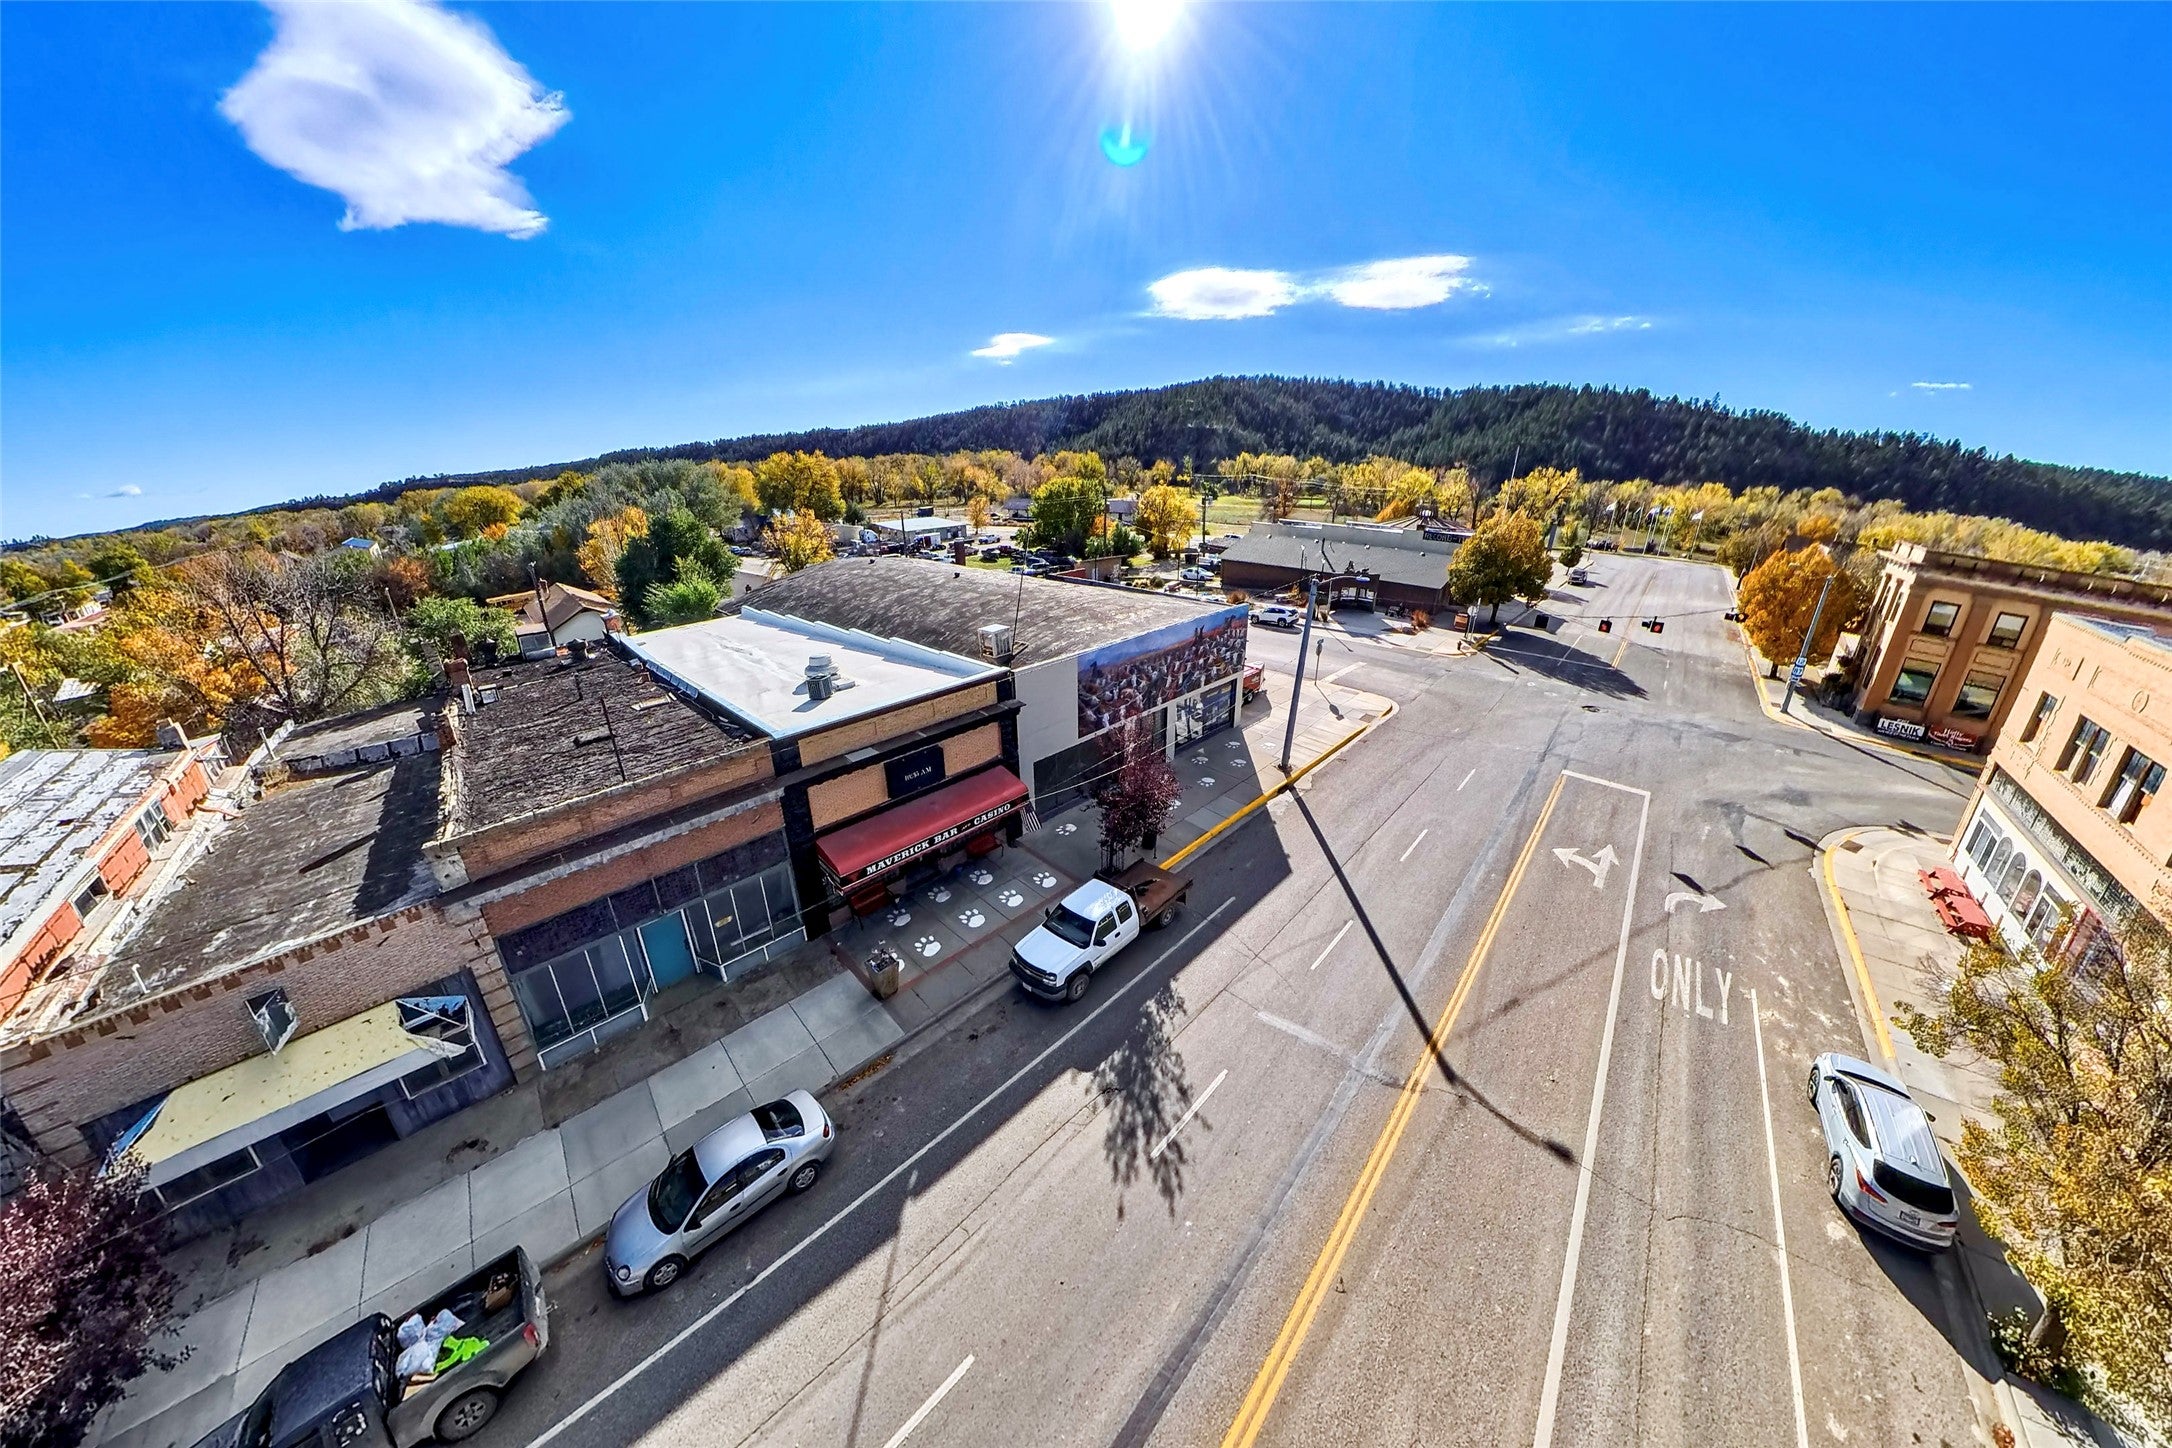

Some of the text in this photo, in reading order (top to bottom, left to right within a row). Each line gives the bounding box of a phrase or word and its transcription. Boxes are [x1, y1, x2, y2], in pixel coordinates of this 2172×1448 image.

[1880, 720, 1921, 736] LESNIK
[866, 841, 930, 876] MAVERICK
[933, 827, 958, 844] BAR
[973, 803, 1011, 825] CASINO
[1651, 948, 1732, 1025] ONLY
